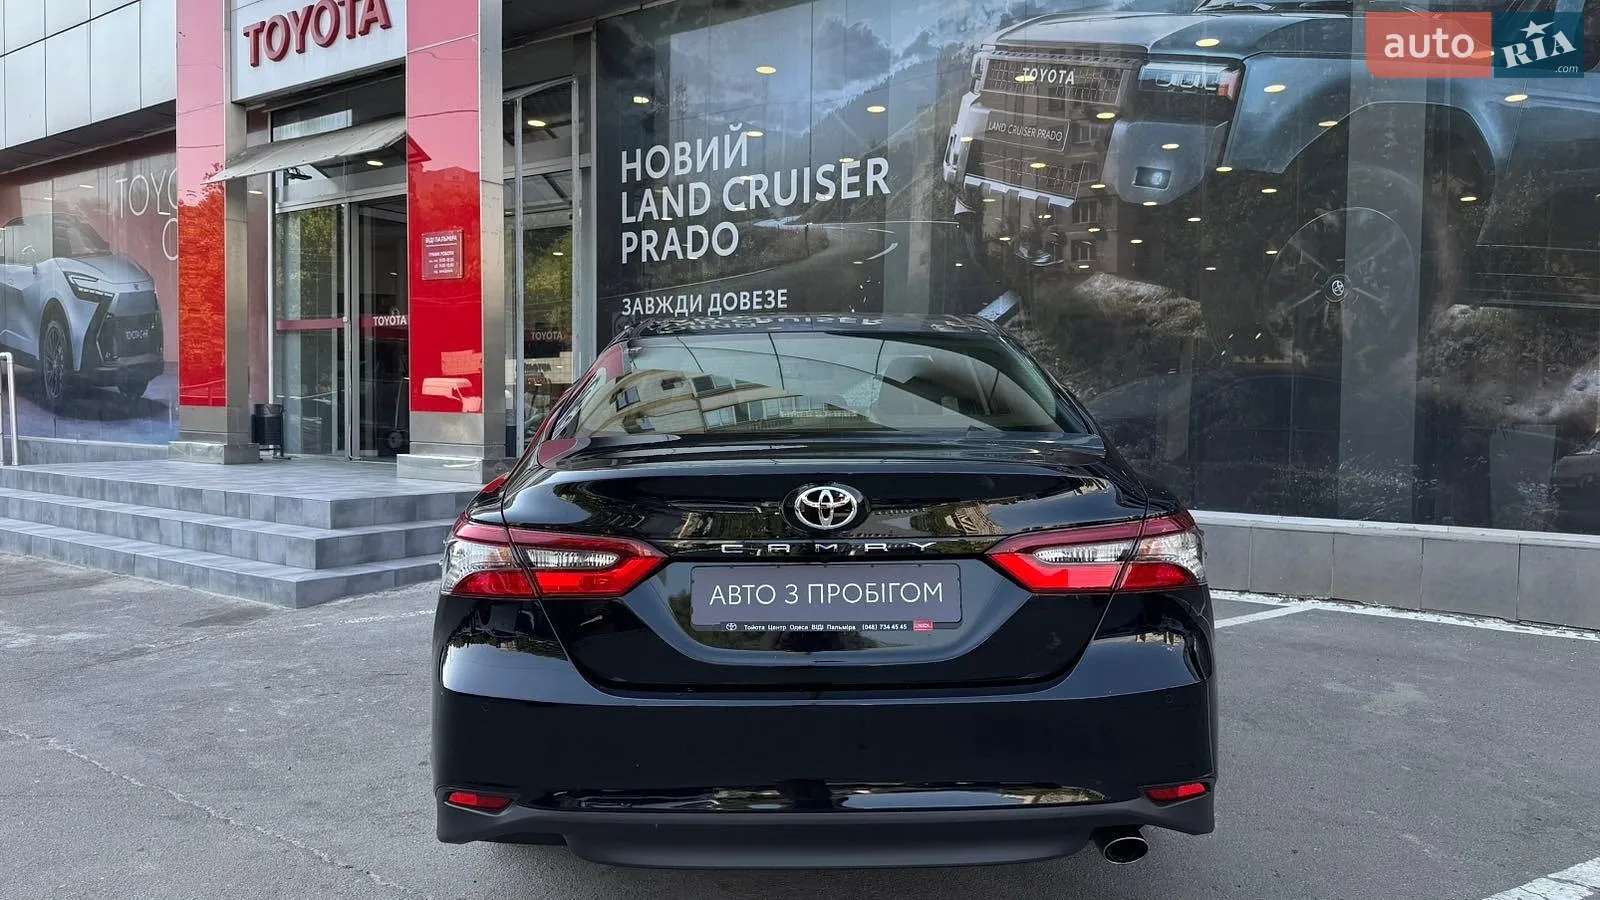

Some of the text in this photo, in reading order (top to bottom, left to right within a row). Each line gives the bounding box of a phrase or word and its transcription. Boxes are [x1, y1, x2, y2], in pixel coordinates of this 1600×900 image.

[243, 0, 392, 67] TOYOTA
[1022, 67, 1075, 85] TOYOTA
[988, 121, 1063, 141] LAND CRUISER PRADO
[621, 122, 748, 184] НОВИЙ
[621, 157, 891, 224] LAND CRUISER
[621, 221, 739, 264] PRADO
[621, 289, 788, 317] ЗАВЖДИ ДОВЕЗЕ
[373, 315, 408, 327] TOYOTA
[531, 330, 563, 341] TOYOTA
[721, 542, 937, 553] CAMRY
[709, 584, 776, 606] АВТО
[808, 582, 943, 604] ПРОБІГОМ
